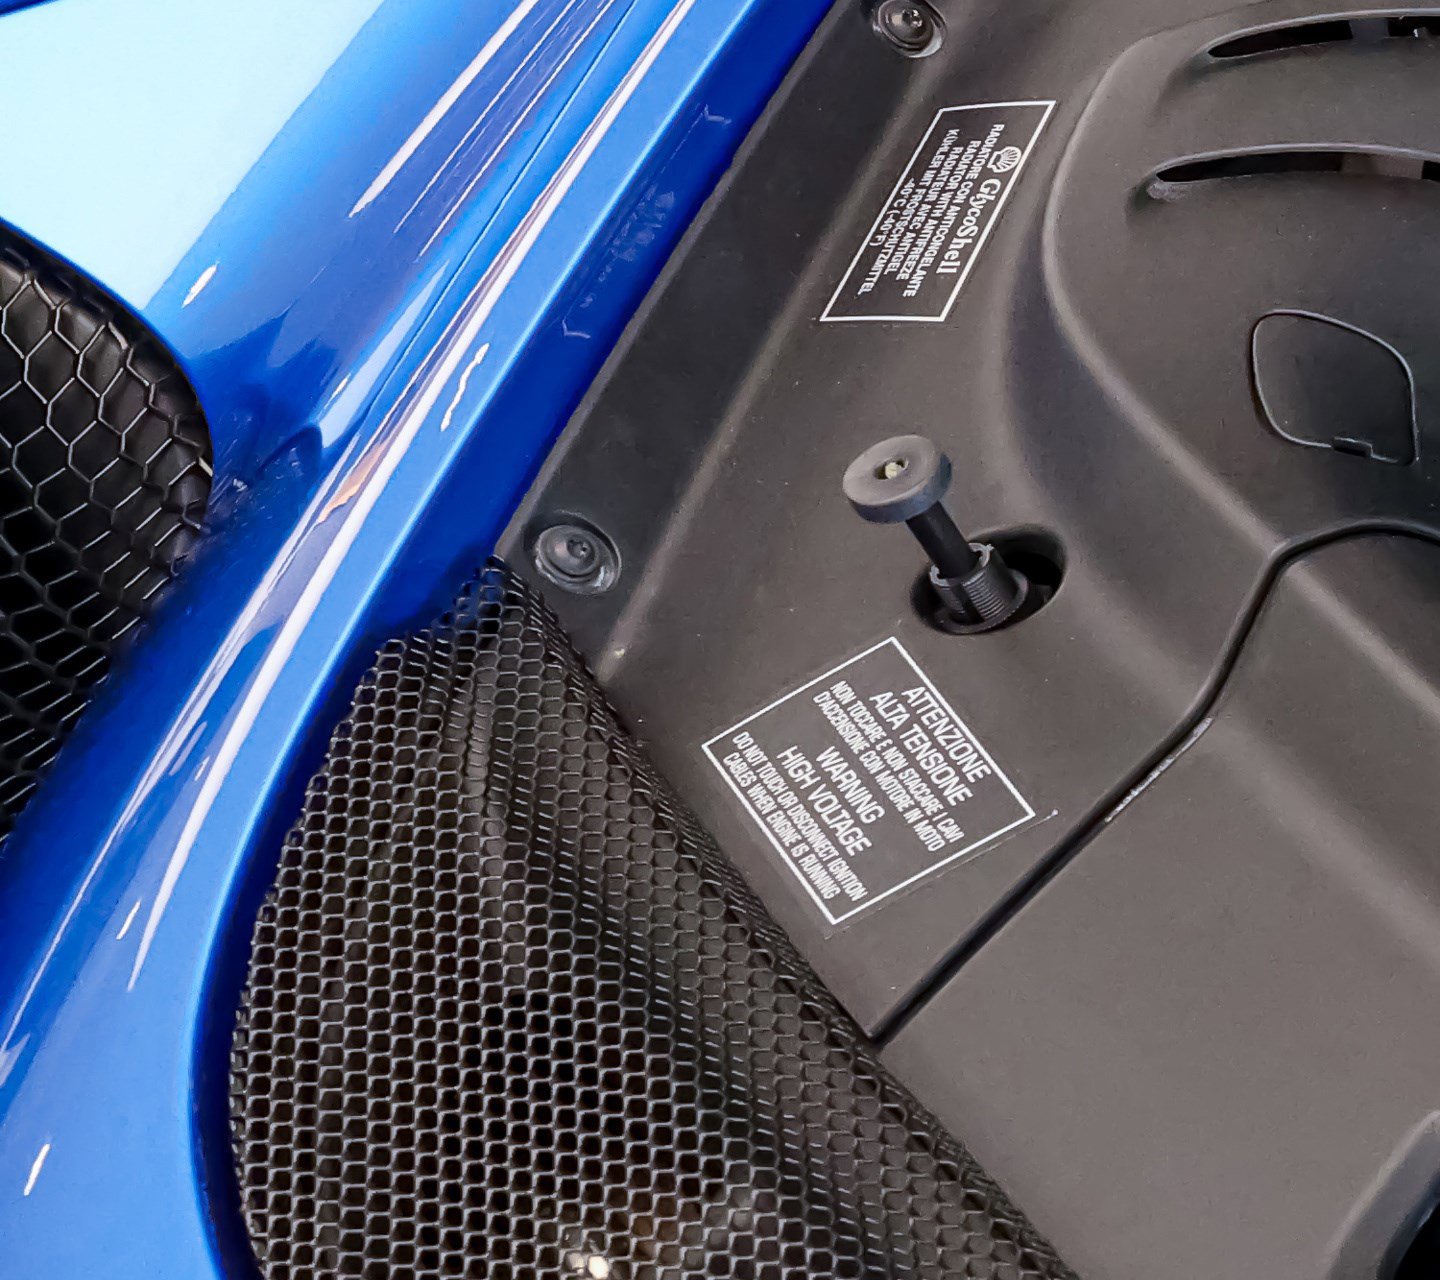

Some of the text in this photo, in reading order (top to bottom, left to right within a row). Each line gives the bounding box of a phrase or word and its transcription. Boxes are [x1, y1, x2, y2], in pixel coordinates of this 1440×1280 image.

[856, 128, 960, 295] KÜHLER MIT FROSTSCHUTZMITTEL
[882, 146, 964, 275] RADIATEUR AVEC ANTIGEL
[895, 139, 982, 280] RADIATOR WITH ANTIFREEZE
[901, 123, 1005, 297] RADIATORE CON ANTICONGELANTE
[935, 177, 1002, 274] GlycoShell
[829, 680, 857, 705] NON
[846, 699, 887, 743] TOCCARE
[874, 738, 893, 751] E
[900, 685, 991, 783] ATTENZIONE
[775, 744, 872, 856] HIGH VOLTAGE
[812, 690, 946, 851] D'ACCENSIONE CON MOTORE IN MOTO
[815, 745, 885, 824] WARNING
[868, 691, 973, 806] ALTA TENSIONE
[880, 745, 909, 772] NON
[897, 767, 944, 816] STACCARE
[722, 751, 841, 899] CABLES WHEN ENGINE IS RUNNING
[731, 730, 868, 901] DO NOT TOUCH OR DISCONNECT IGNITION
[936, 817, 965, 843] CAVI
